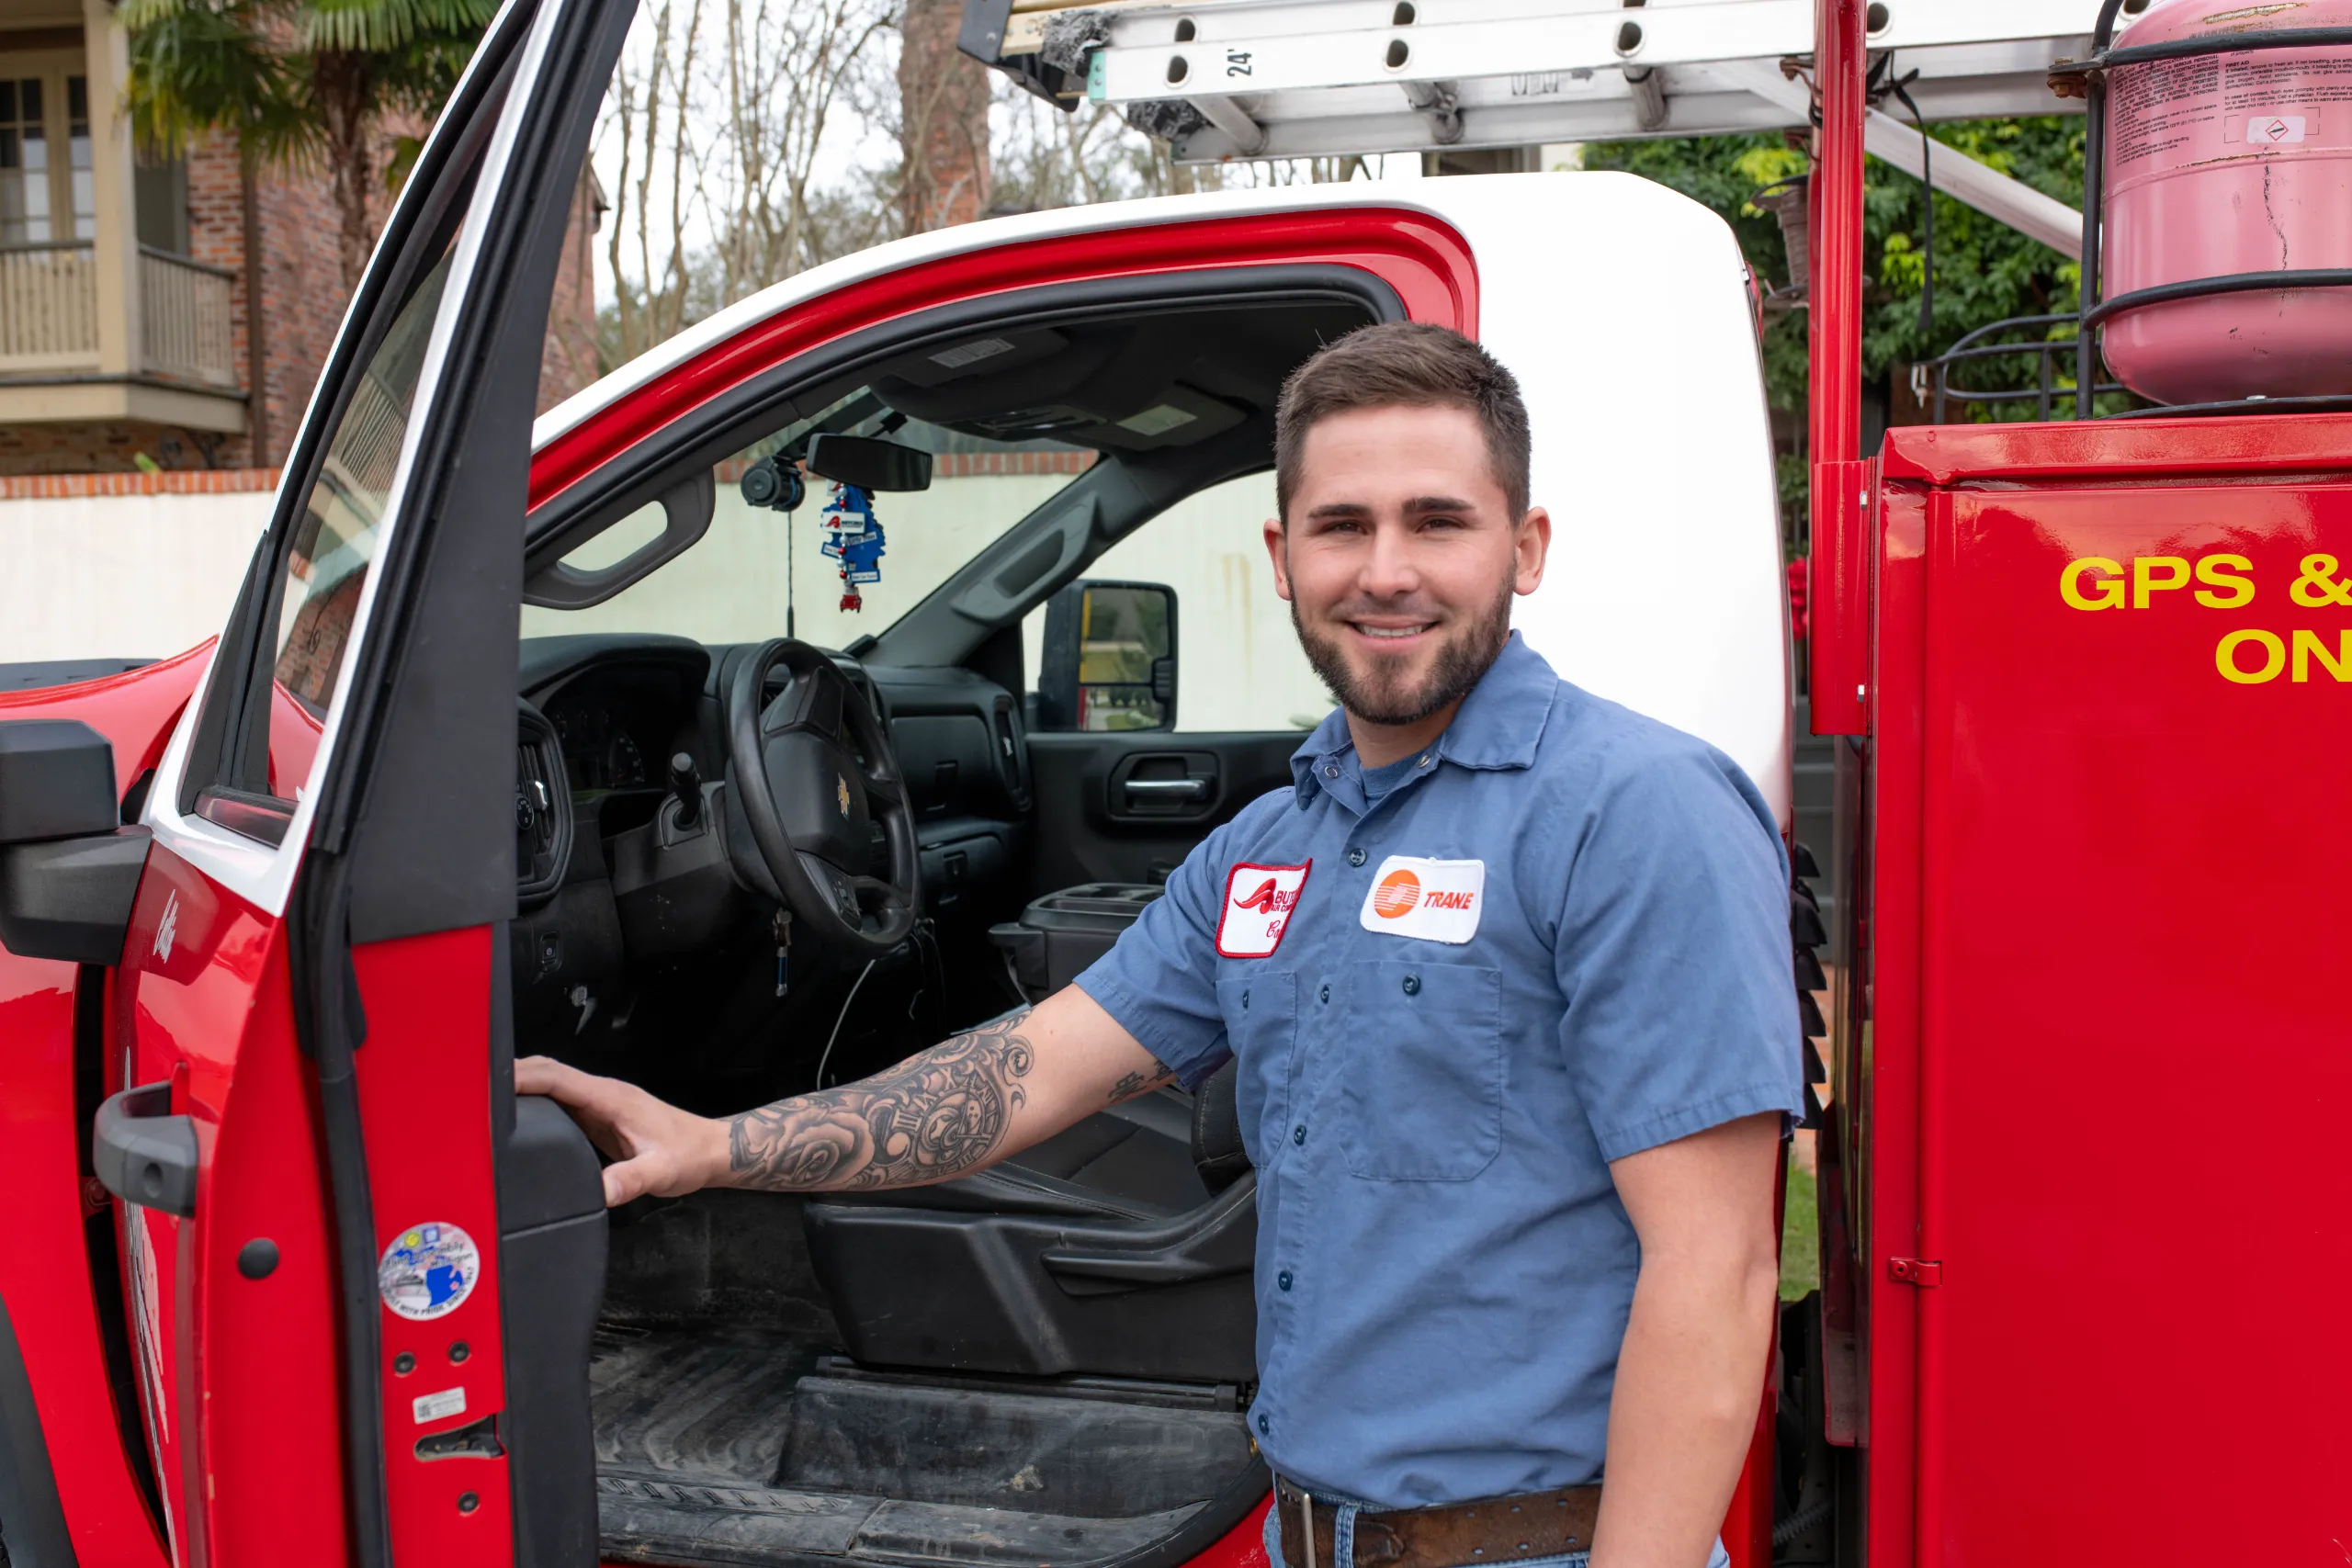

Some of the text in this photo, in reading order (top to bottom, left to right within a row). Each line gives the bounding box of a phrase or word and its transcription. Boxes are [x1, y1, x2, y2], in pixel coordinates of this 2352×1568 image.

[2192, 65, 2218, 74] CORROSIVE
[2154, 81, 2171, 89] CONTACT
[2060, 553, 2352, 611] GPS &
[2215, 629, 2352, 684] ON
[1424, 891, 1474, 910] TRANE
[422, 1304, 444, 1316] PRIDE
